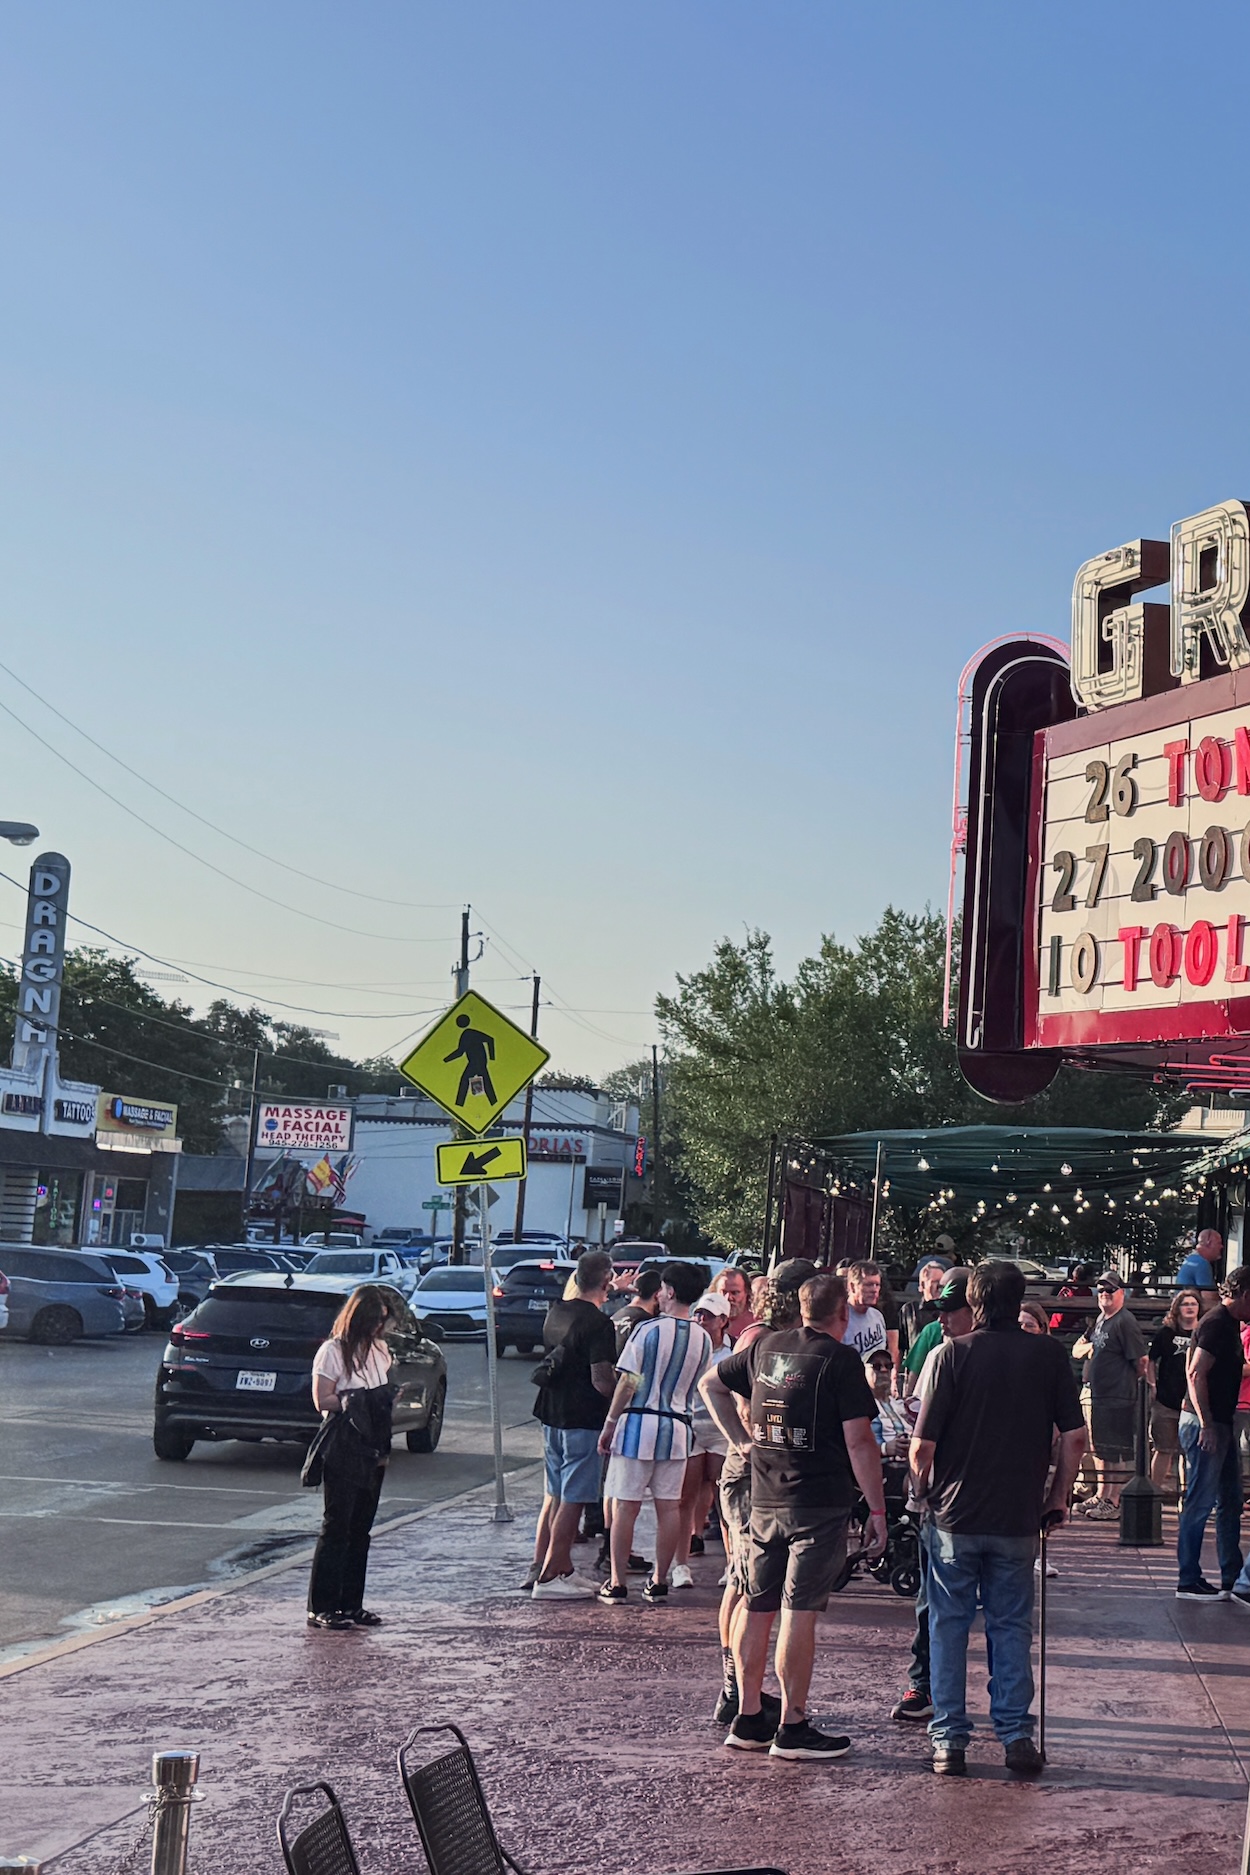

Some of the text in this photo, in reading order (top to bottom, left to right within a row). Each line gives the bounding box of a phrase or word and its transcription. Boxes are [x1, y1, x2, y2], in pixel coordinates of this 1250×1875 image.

[1084, 753, 1138, 823] 26
[1052, 844, 1110, 912] 27
[21, 871, 61, 1044] DRAGNA
[1048, 931, 1099, 996] 10
[154, 1110, 173, 1123] FACIAL
[264, 1106, 348, 1121] MASSAGE
[282, 1120, 342, 1134] FACIAL
[261, 1131, 346, 1143] HEAD THERAPY
[268, 1139, 338, 1149] 945-278-1256
